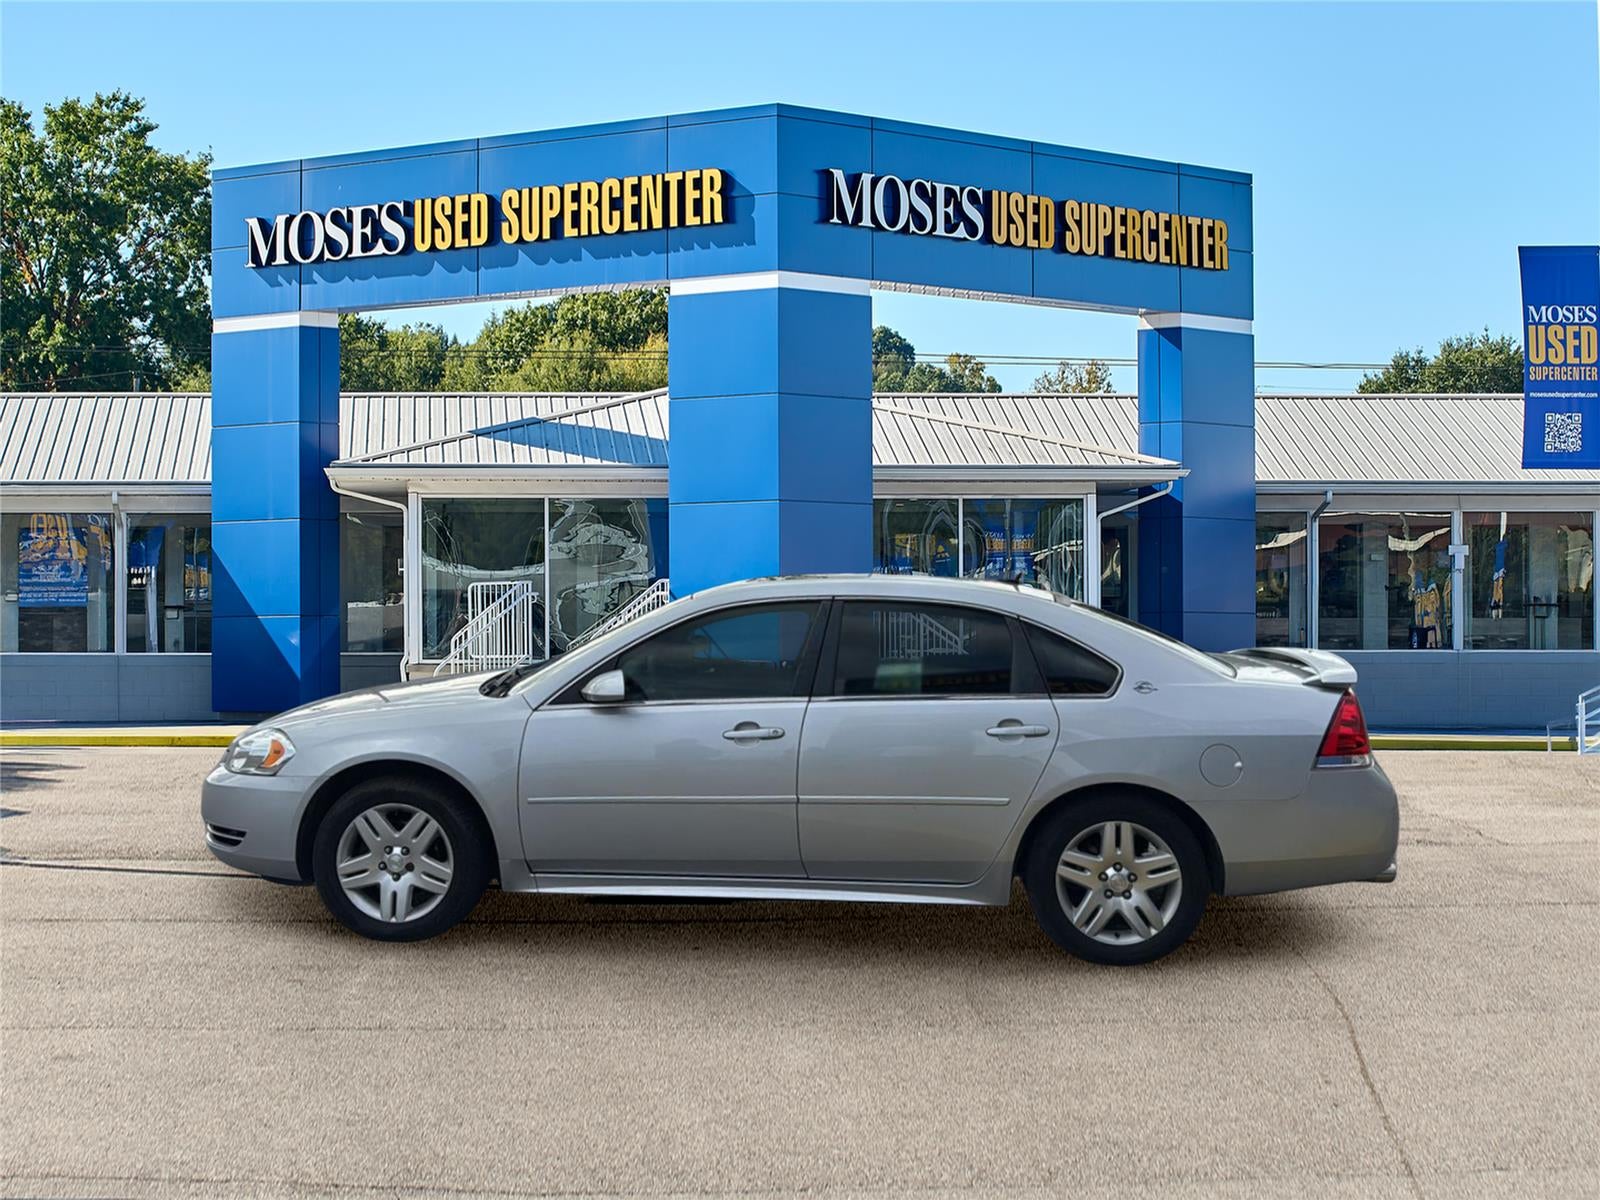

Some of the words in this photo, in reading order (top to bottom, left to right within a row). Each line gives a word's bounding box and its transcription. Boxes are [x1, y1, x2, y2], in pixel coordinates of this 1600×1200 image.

[244, 200, 406, 268] MOSES
[413, 193, 488, 252] USED
[501, 168, 723, 245] SUPERCENTER
[829, 168, 984, 241] MOSES
[991, 190, 1055, 249] USED
[1065, 200, 1229, 271] SUPERCENTER
[1528, 305, 1597, 323] MOSES
[1529, 325, 1598, 365] USED
[1529, 367, 1598, 381] SUPERCENTER
